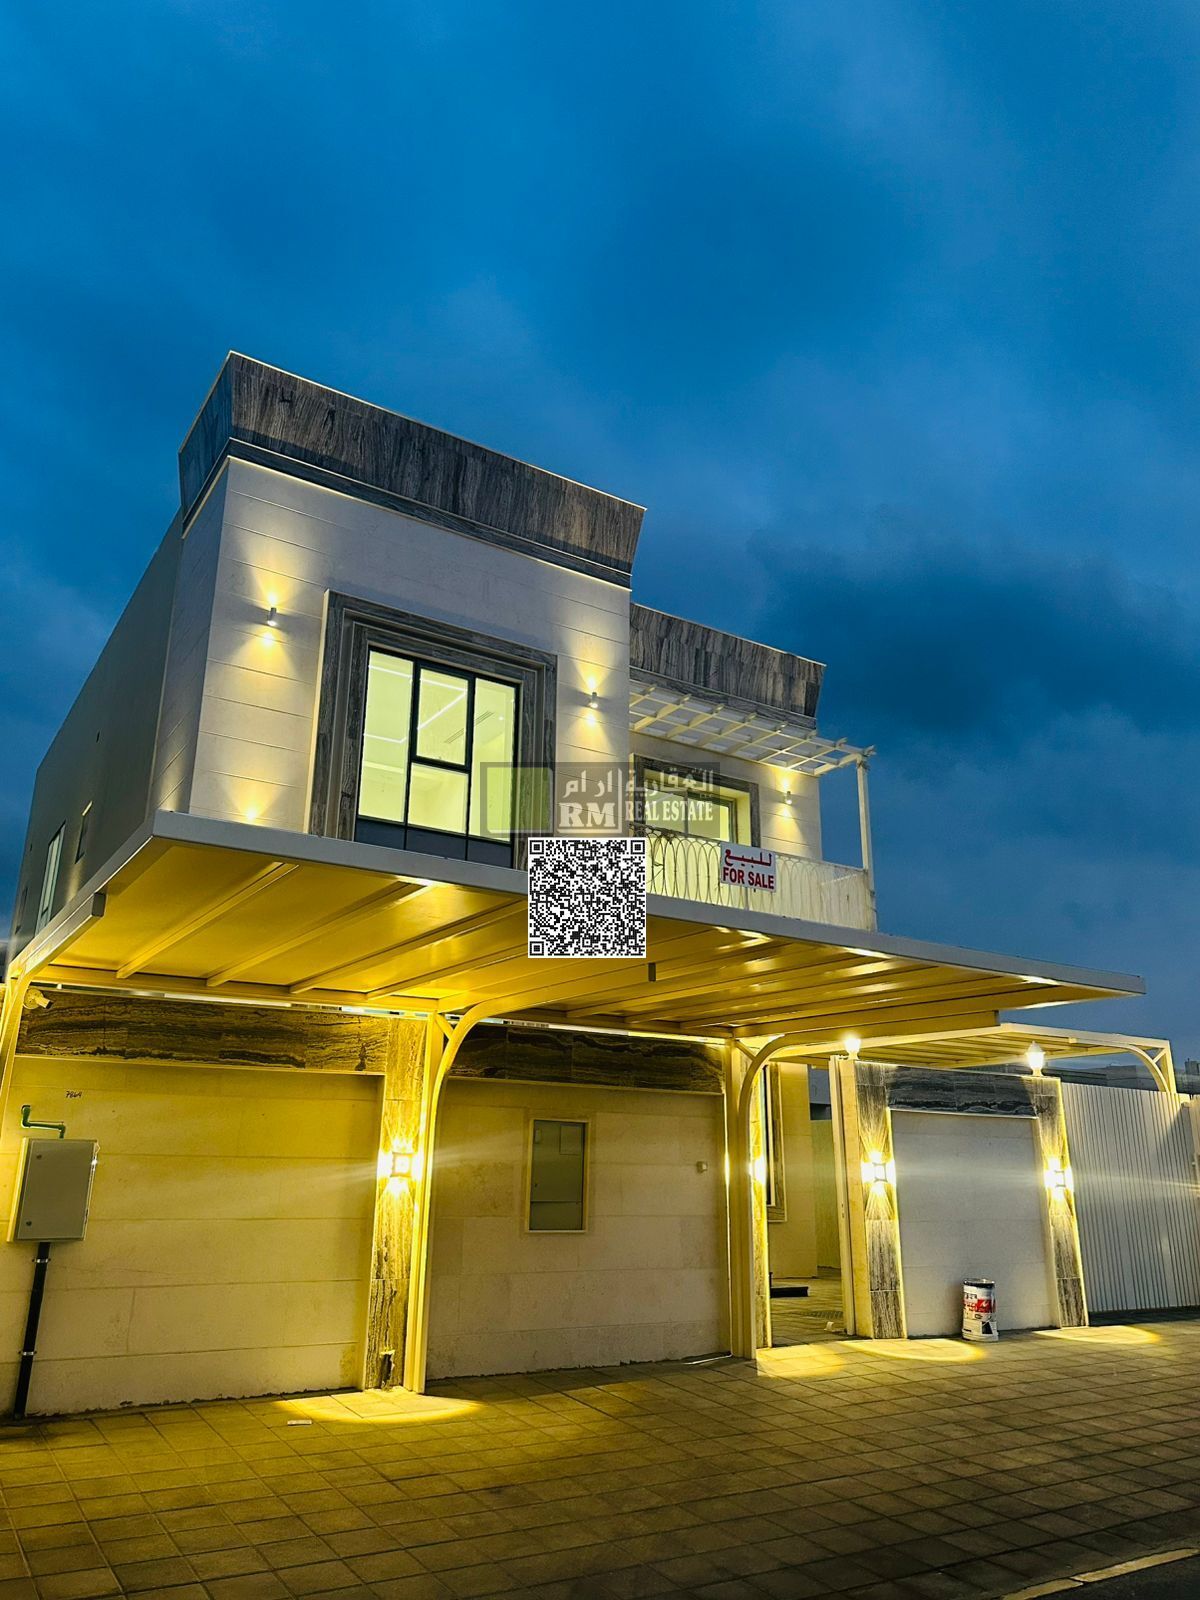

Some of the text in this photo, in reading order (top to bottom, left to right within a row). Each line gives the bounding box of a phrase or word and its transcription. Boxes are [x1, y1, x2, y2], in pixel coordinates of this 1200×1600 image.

[725, 849, 772, 868] للبيع
[723, 867, 774, 890] FOR SALE
